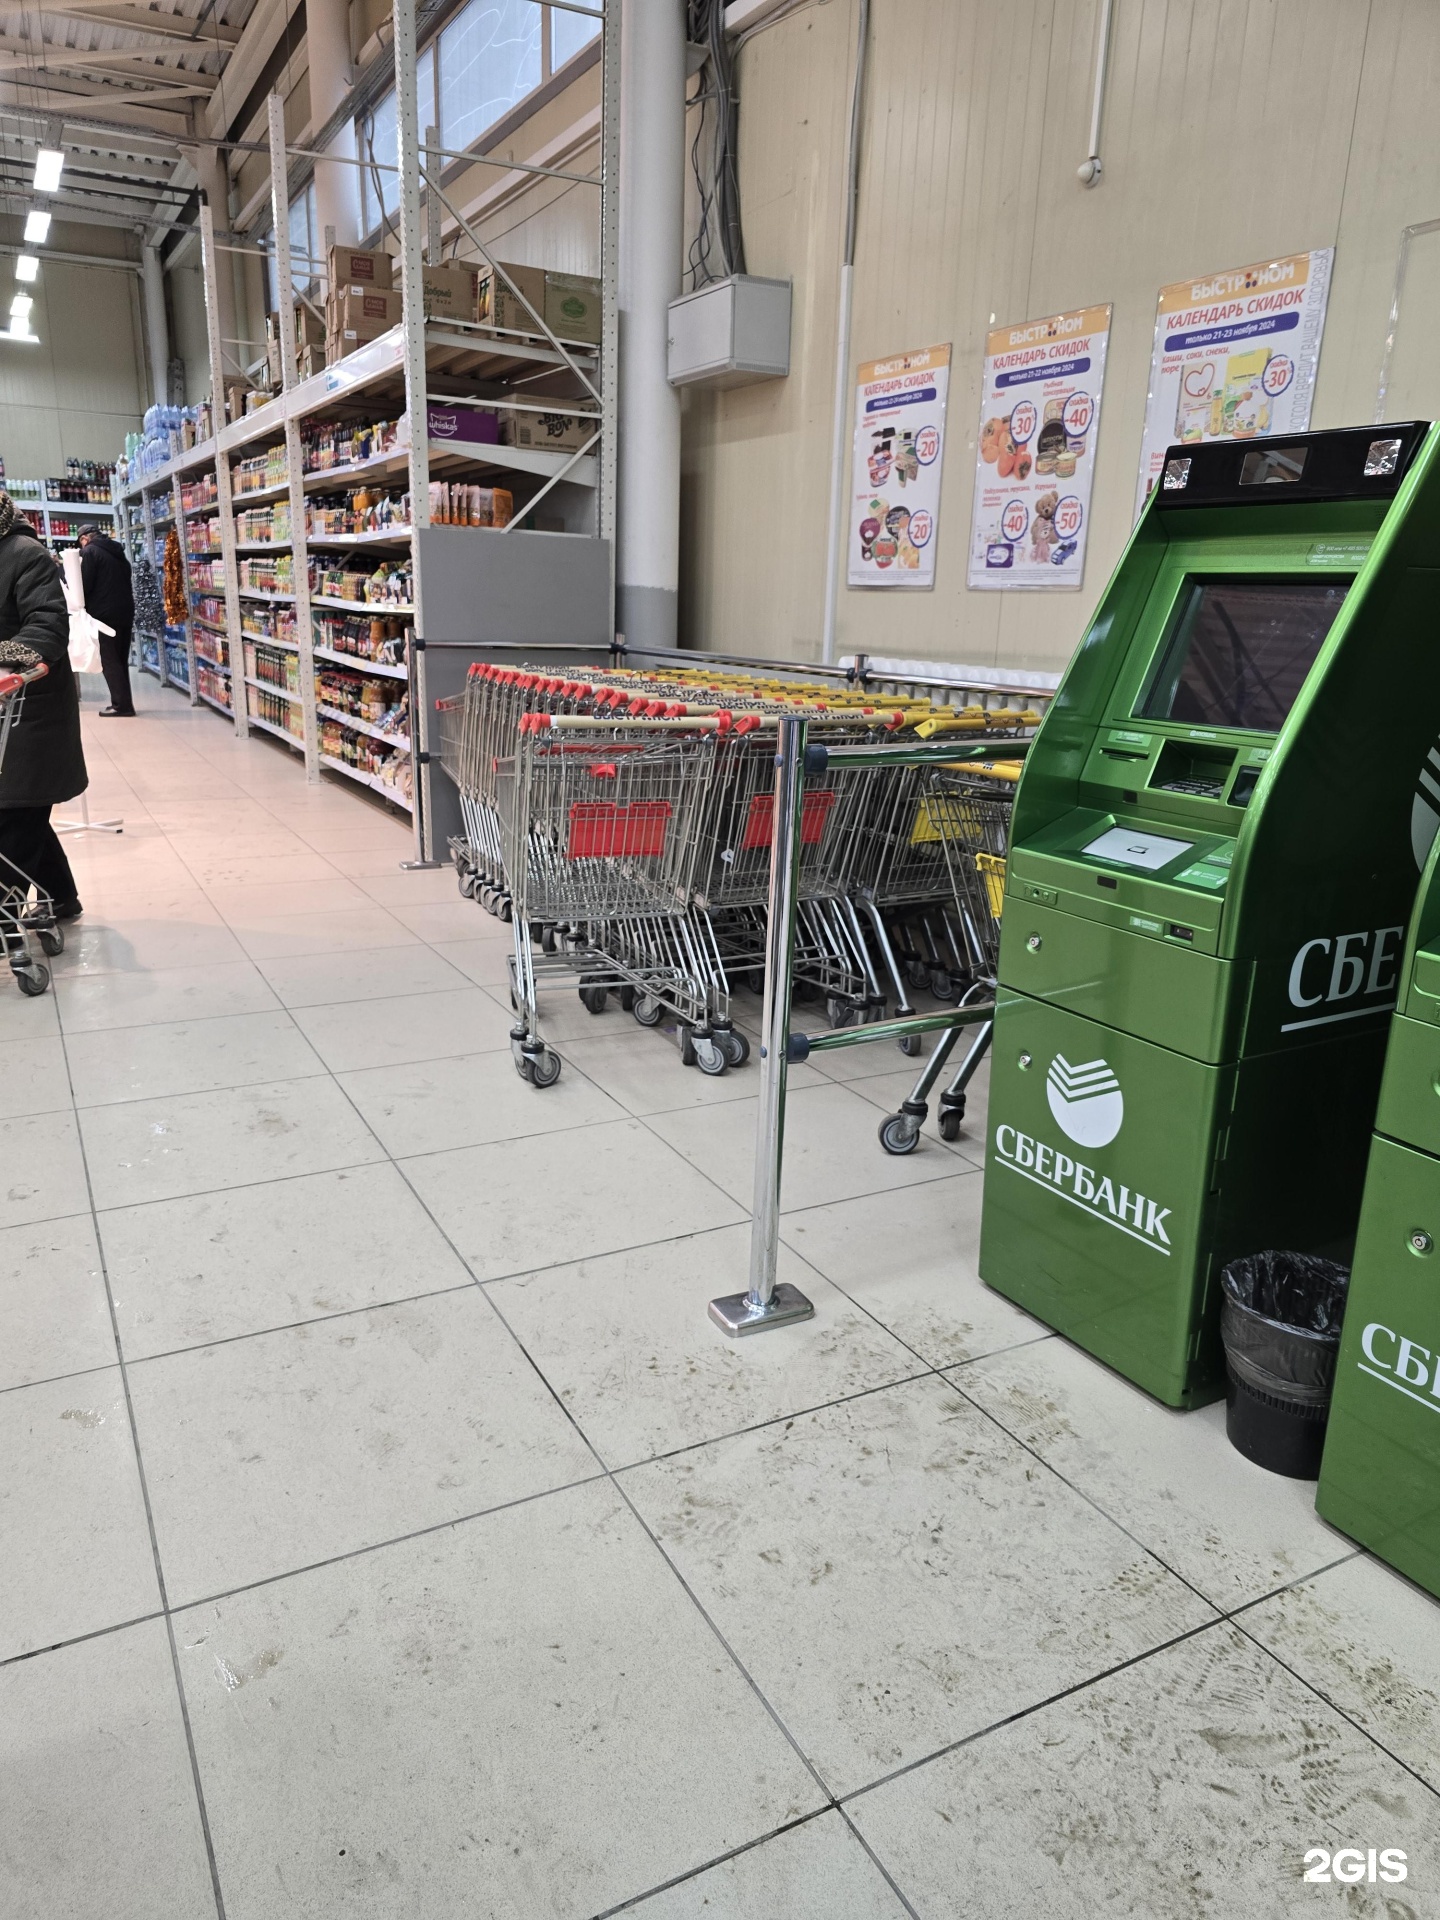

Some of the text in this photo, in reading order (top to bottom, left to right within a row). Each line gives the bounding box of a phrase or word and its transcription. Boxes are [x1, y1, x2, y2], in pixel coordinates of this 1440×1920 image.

[1167, 288, 1306, 330] КАЛЕНДАРЬ СКИДОК
[1185, 319, 1276, 344] только 21-23 ноября 2024
[993, 338, 1091, 370] КАЛЕНДАРЬ СКИДОК
[1062, 363, 1075, 372] 2024
[864, 371, 936, 397] КАЛЕНДАРЬ СКИДОК
[428, 420, 458, 431] whiskas
[1287, 393, 1309, 433] КОГОЛЯ
[1288, 925, 1404, 1008] СБЕ
[996, 1124, 1172, 1245] СБЕРБАНК
[1361, 1323, 1440, 1399] СБ
